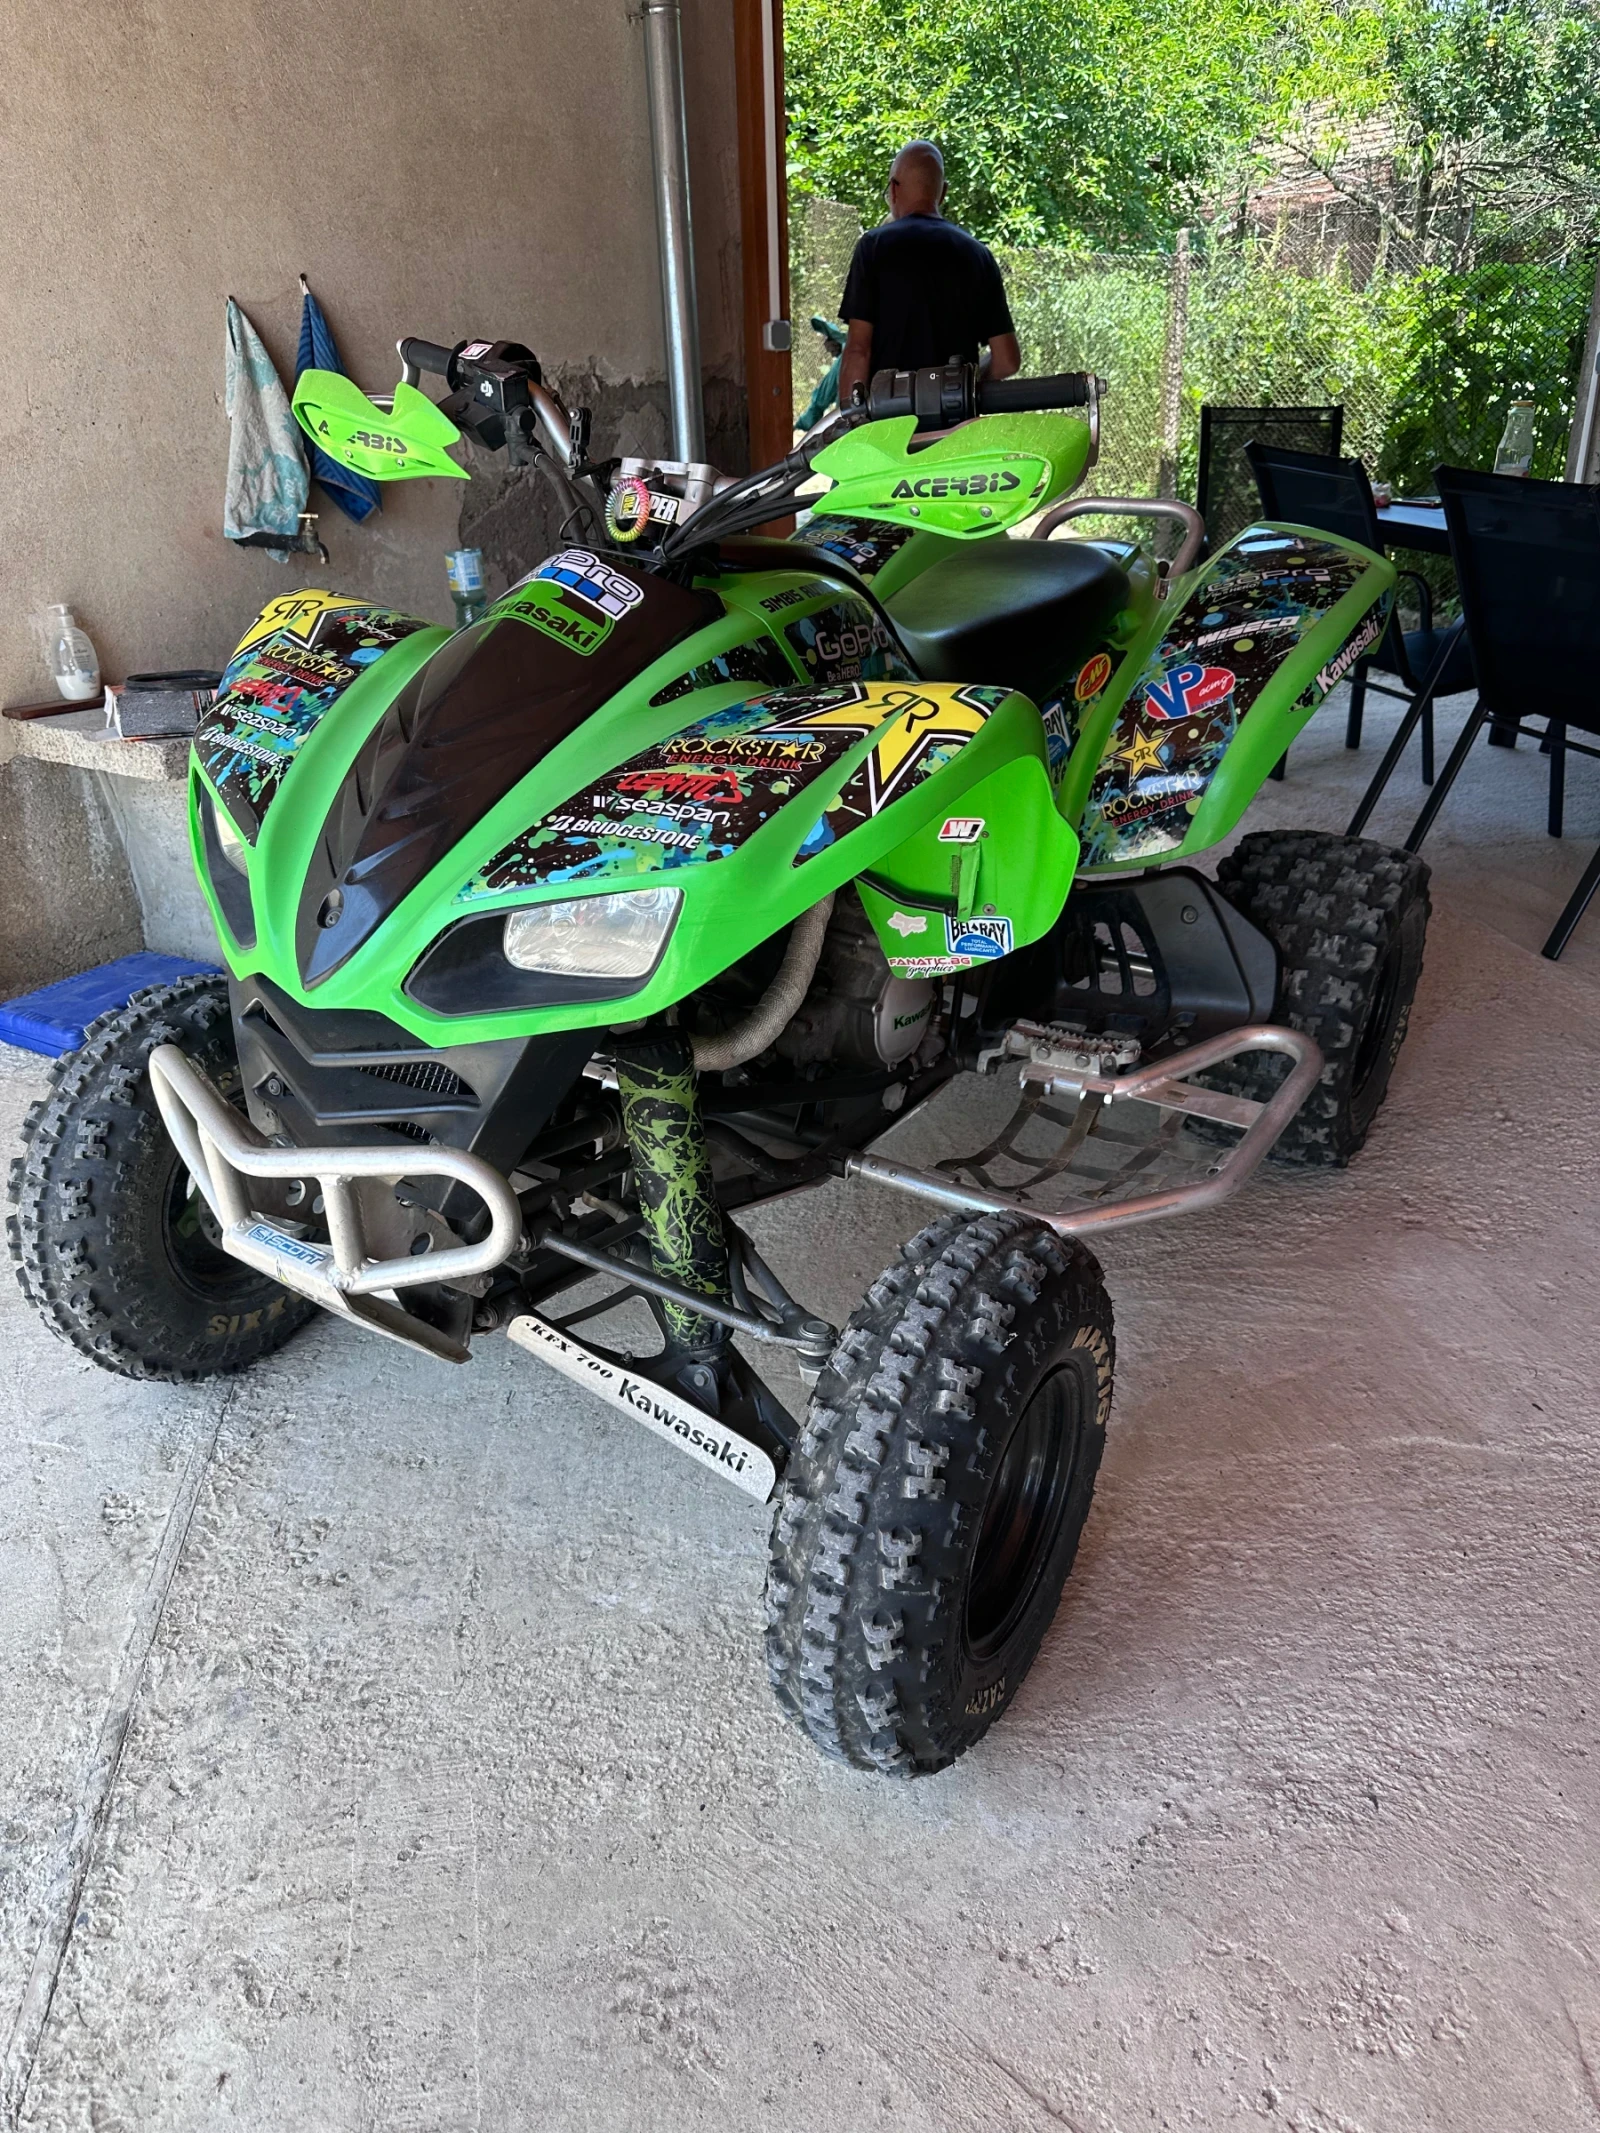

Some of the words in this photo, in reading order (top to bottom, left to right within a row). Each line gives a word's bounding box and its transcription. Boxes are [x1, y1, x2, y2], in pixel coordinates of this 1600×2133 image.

[546, 551, 641, 602] Pro
[815, 623, 889, 661] GoPro
[1315, 614, 1380, 695] Kawasaki
[293, 667, 326, 686] DRINK
[1143, 663, 1204, 720] VP
[232, 709, 298, 740] seaspan
[212, 729, 286, 766] BRIDGESTONE
[669, 753, 739, 766] ENERGY
[746, 756, 801, 771] DRINK
[616, 797, 731, 825] seaspan
[1112, 805, 1155, 828] ENERGY
[1160, 791, 1196, 810] DRINK
[570, 818, 703, 850] BRIDGESTONE
[889, 957, 970, 966] FANATIC.BG
[907, 963, 954, 978] graphics
[266, 1236, 326, 1265] SCOTT
[530, 1323, 573, 1354] KFX
[575, 1352, 614, 1380] 700
[618, 1378, 750, 1474] Kawasaki
